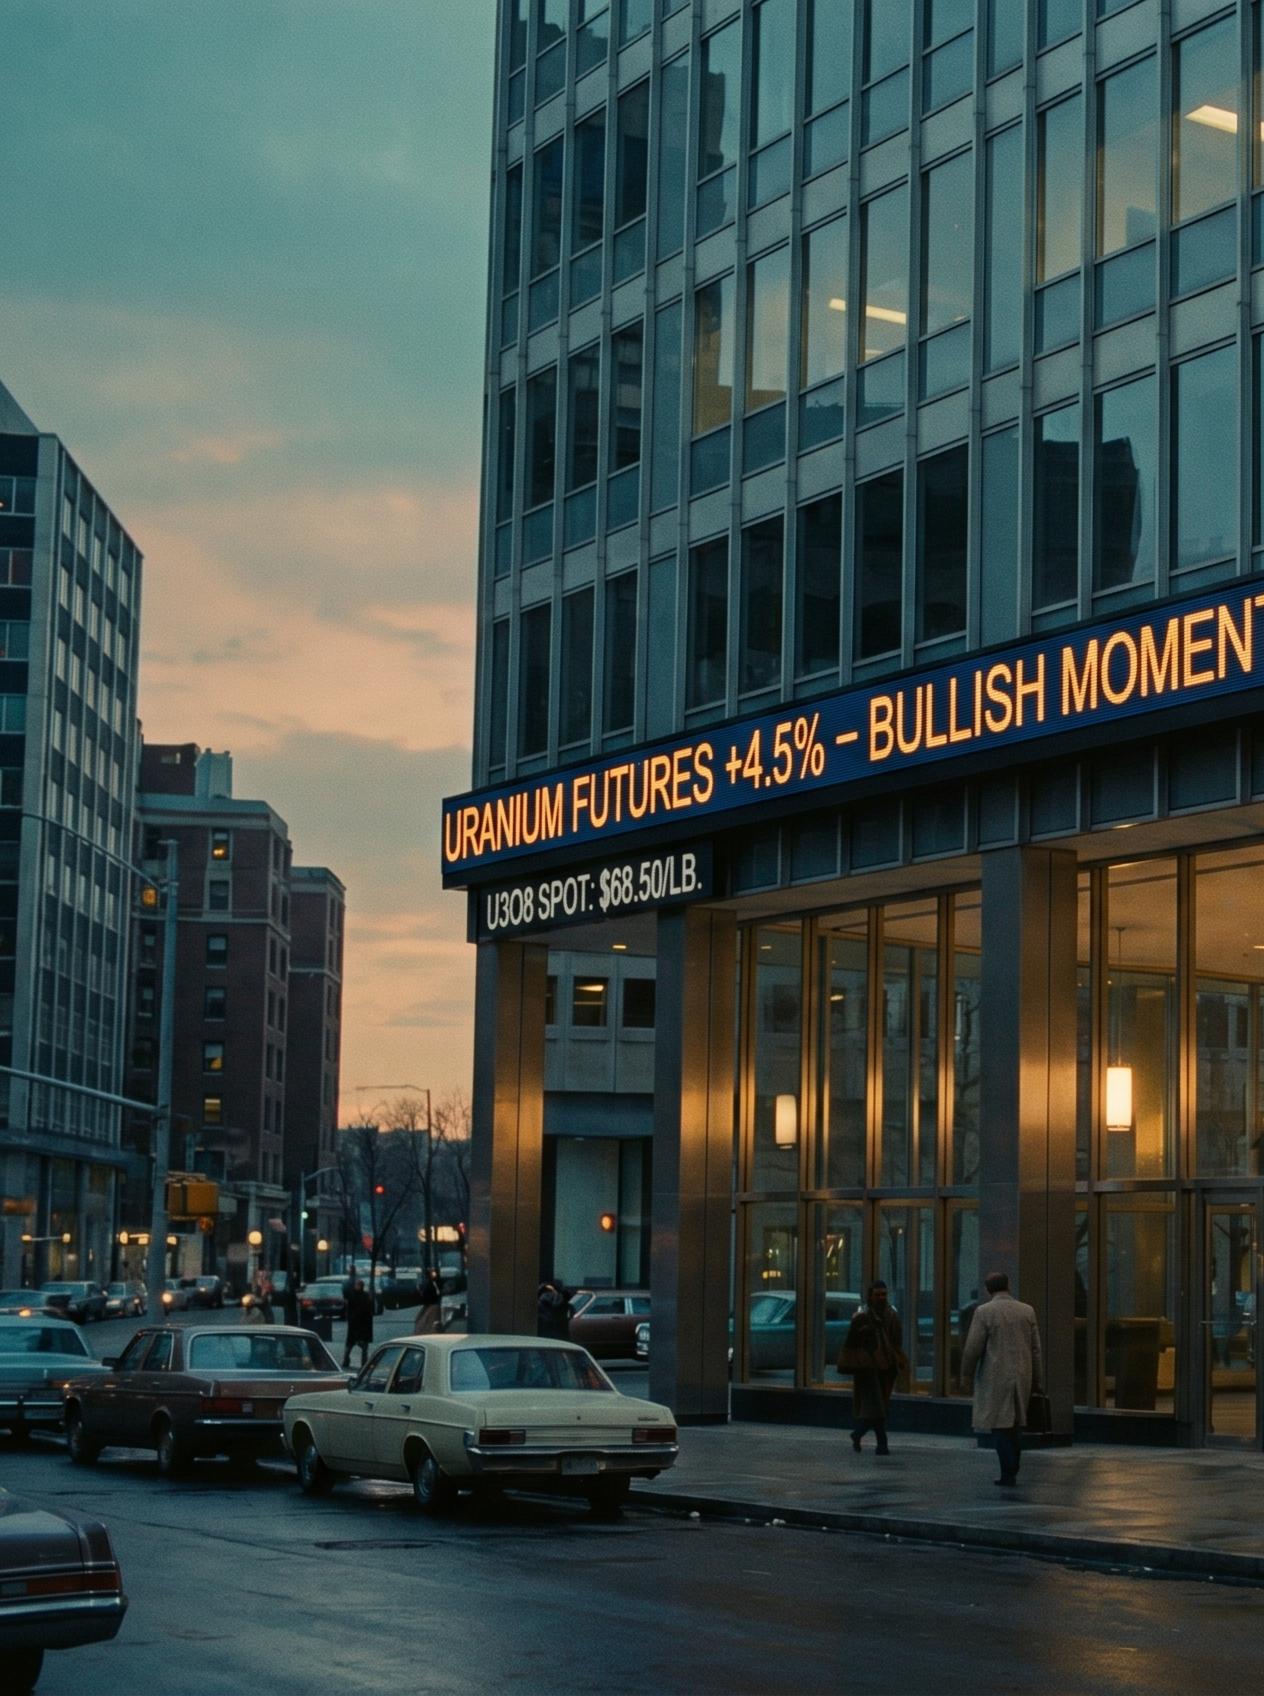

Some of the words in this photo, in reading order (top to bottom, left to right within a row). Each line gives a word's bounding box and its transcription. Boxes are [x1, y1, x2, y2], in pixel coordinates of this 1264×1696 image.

[445, 782, 563, 863] URANIUM
[572, 742, 714, 832] FUTURES
[725, 713, 825, 789] +4.5%
[869, 654, 1045, 761] BULLISH
[538, 873, 594, 920] SPOT:
[598, 852, 703, 913] $68.50/LB.
